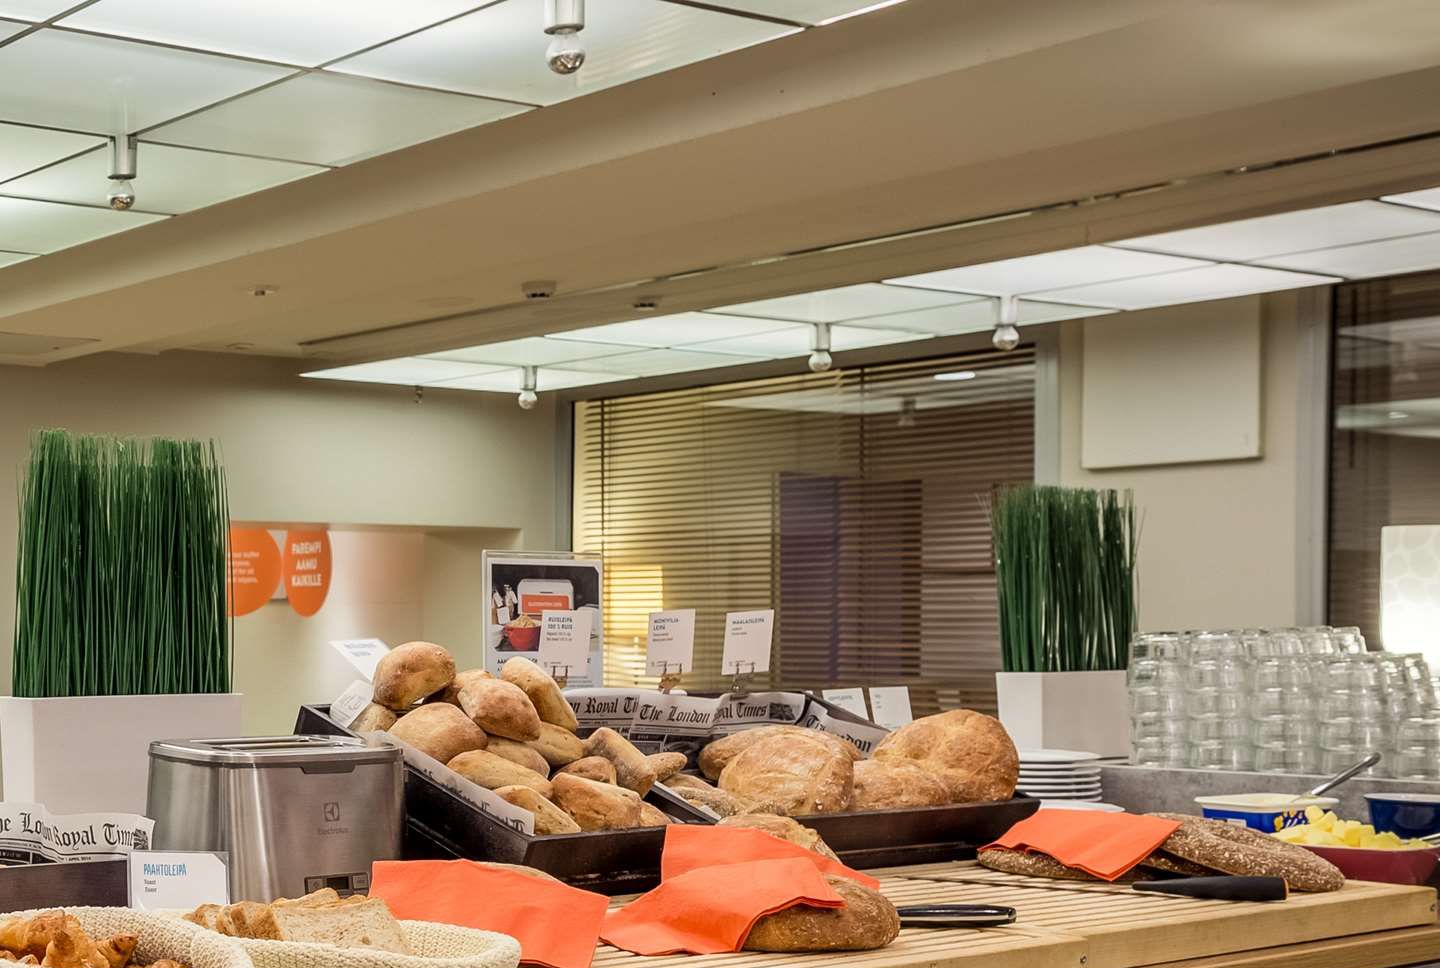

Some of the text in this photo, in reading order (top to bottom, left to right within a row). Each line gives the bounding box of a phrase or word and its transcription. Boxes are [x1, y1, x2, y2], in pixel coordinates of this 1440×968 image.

[640, 703, 663, 720] The
[667, 705, 710, 724] London
[53, 825, 96, 850] Royal
